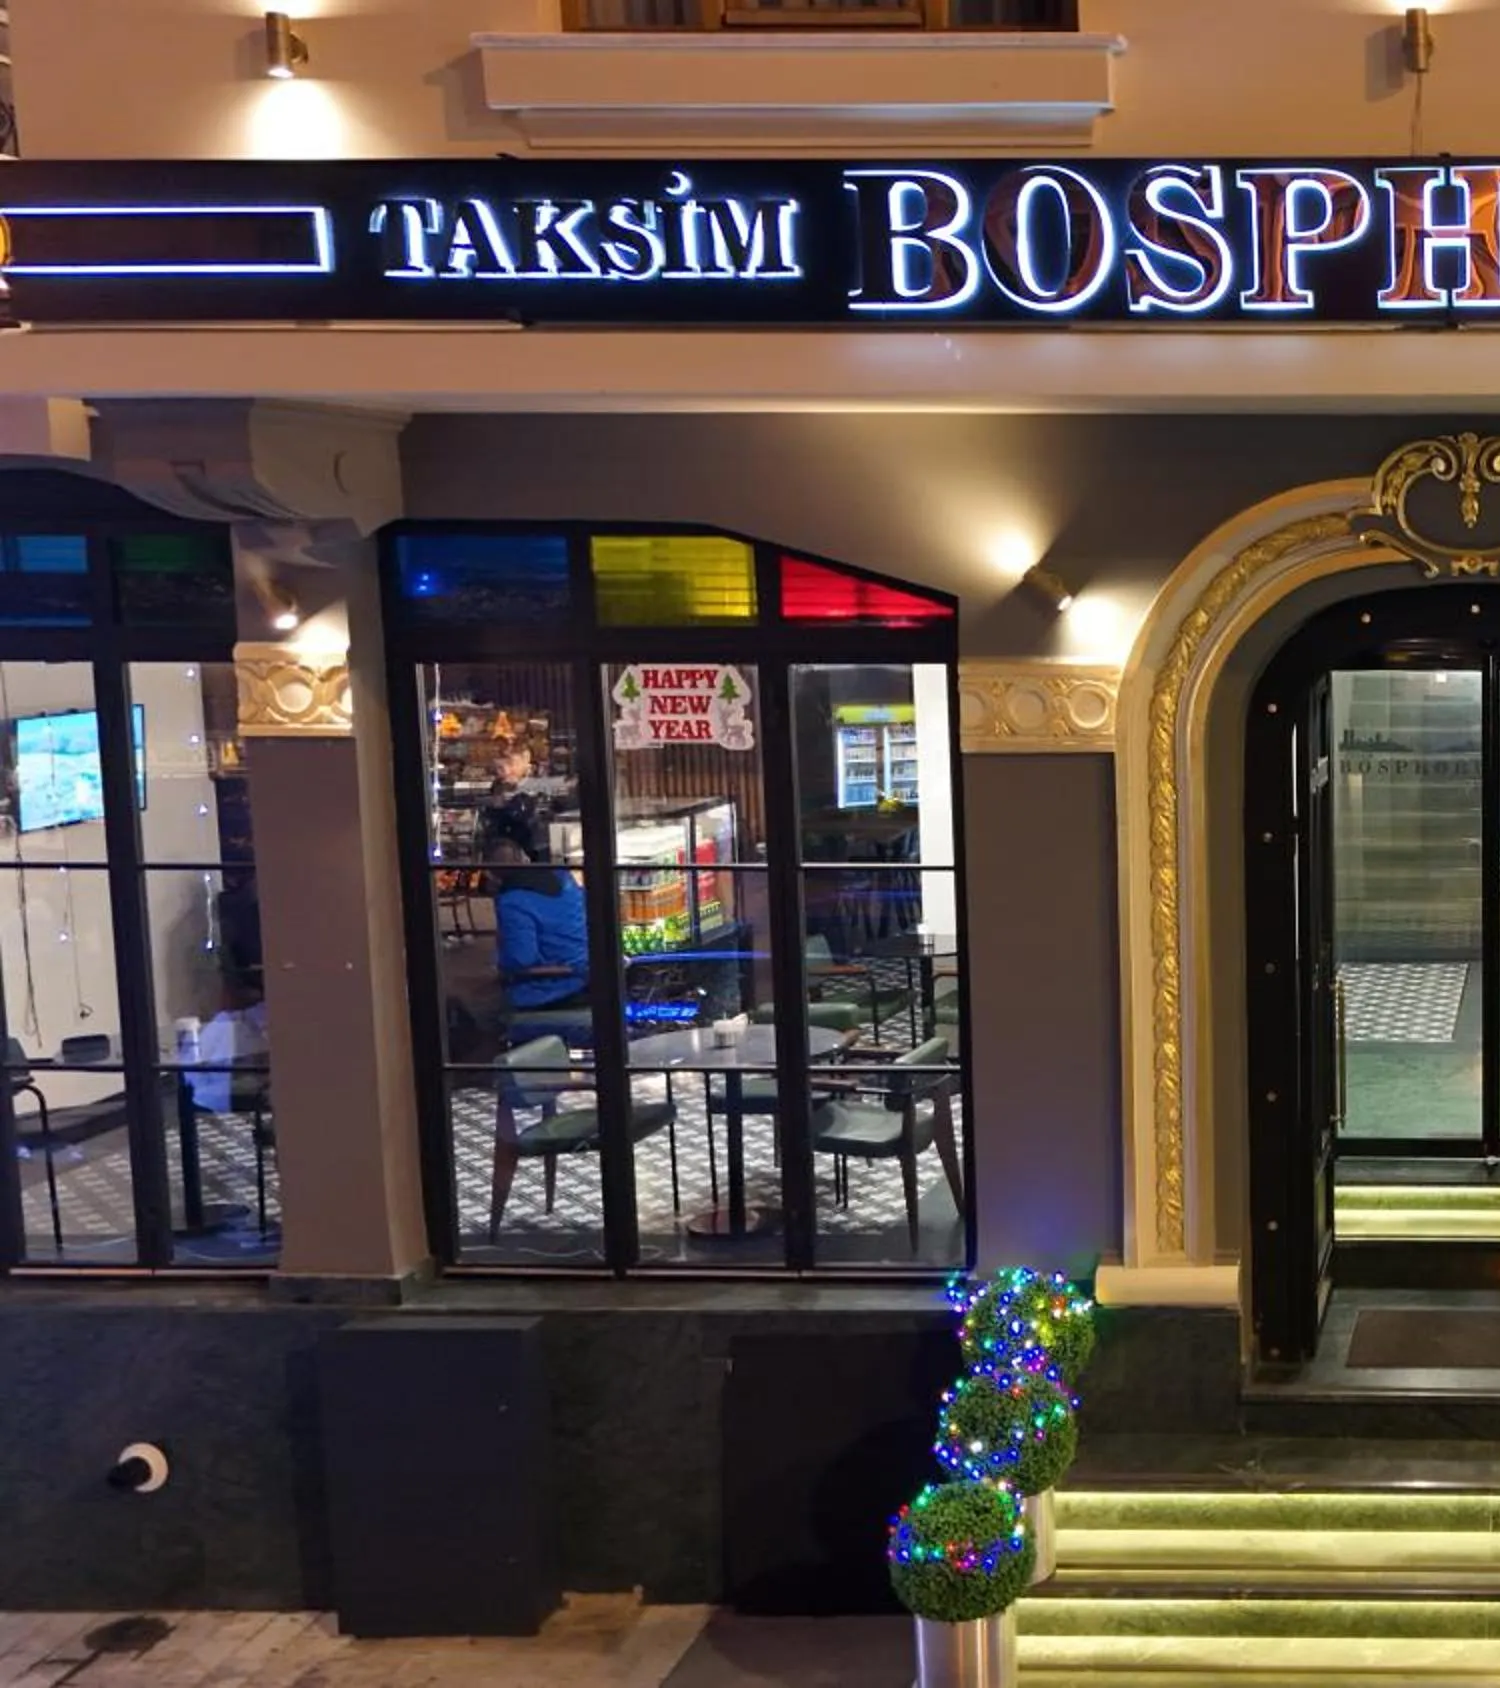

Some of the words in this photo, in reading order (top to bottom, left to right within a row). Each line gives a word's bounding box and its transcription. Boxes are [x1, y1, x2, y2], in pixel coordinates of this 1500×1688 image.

[642, 669, 719, 689] HAPPY
[648, 695, 712, 714] NEW
[648, 720, 712, 739] YEAR
